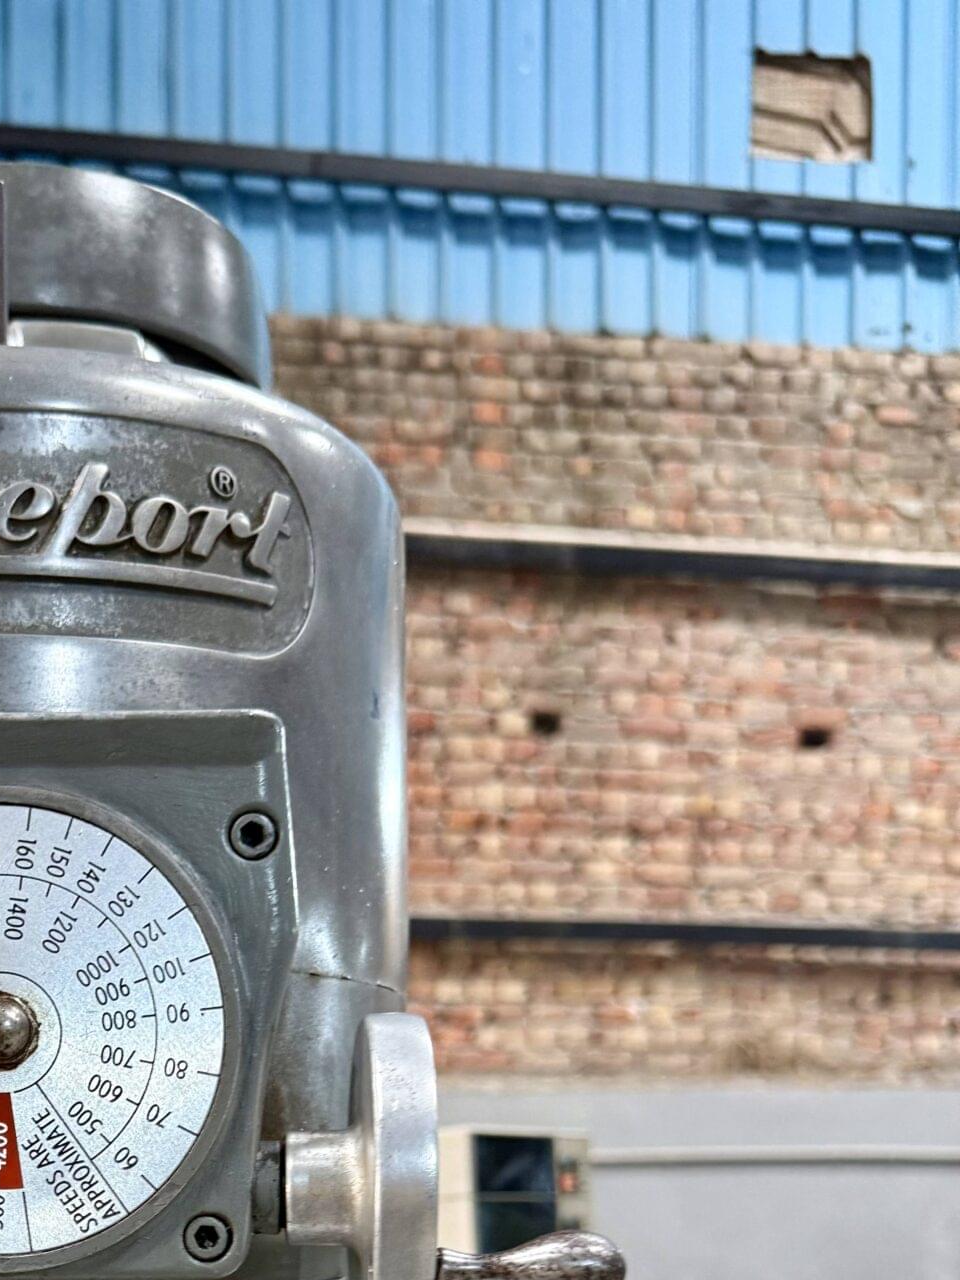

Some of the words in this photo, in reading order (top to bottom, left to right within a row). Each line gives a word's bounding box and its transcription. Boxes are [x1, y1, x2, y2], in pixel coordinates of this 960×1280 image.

[15, 840, 37, 870] 160
[47, 847, 72, 877] 150
[77, 861, 106, 893] 140
[108, 885, 140, 916] 130
[4, 897, 28, 940] 1400
[42, 911, 77, 954] 1200
[134, 919, 166, 948] 120
[77, 951, 119, 987] 1000
[153, 957, 186, 984] 100
[95, 978, 130, 1005] 900
[102, 1012, 136, 1031] 800
[167, 1003, 190, 1023] 90
[101, 1045, 136, 1068] 700
[164, 1058, 188, 1079] 80
[88, 1075, 122, 1102] 600
[68, 1101, 102, 1134] 500
[147, 1104, 172, 1128] 70
[22, 1134, 55, 1169] ARE
[31, 1108, 120, 1220] APPROXIMATE
[114, 1147, 138, 1170] 60
[46, 1170, 98, 1233] SPEEDS
